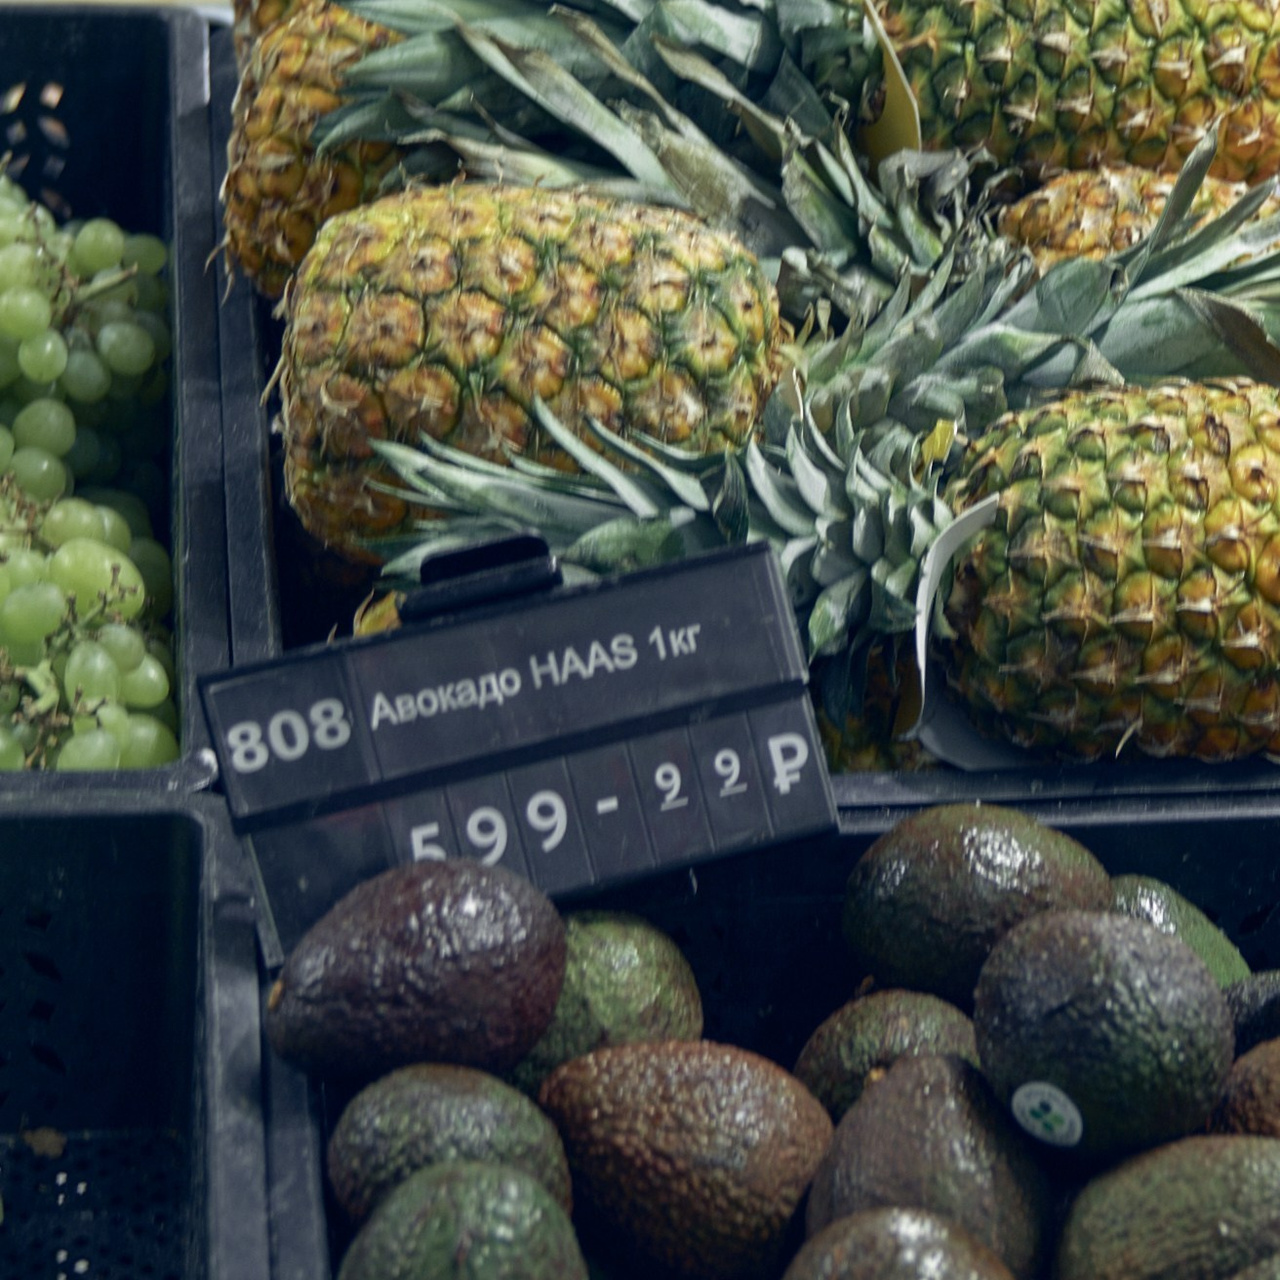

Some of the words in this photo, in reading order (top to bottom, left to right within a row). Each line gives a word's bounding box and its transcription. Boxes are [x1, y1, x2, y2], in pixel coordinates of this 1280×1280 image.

[369, 666, 521, 731] Авокадо
[648, 624, 702, 663] 1кг
[226, 698, 351, 774] 808
